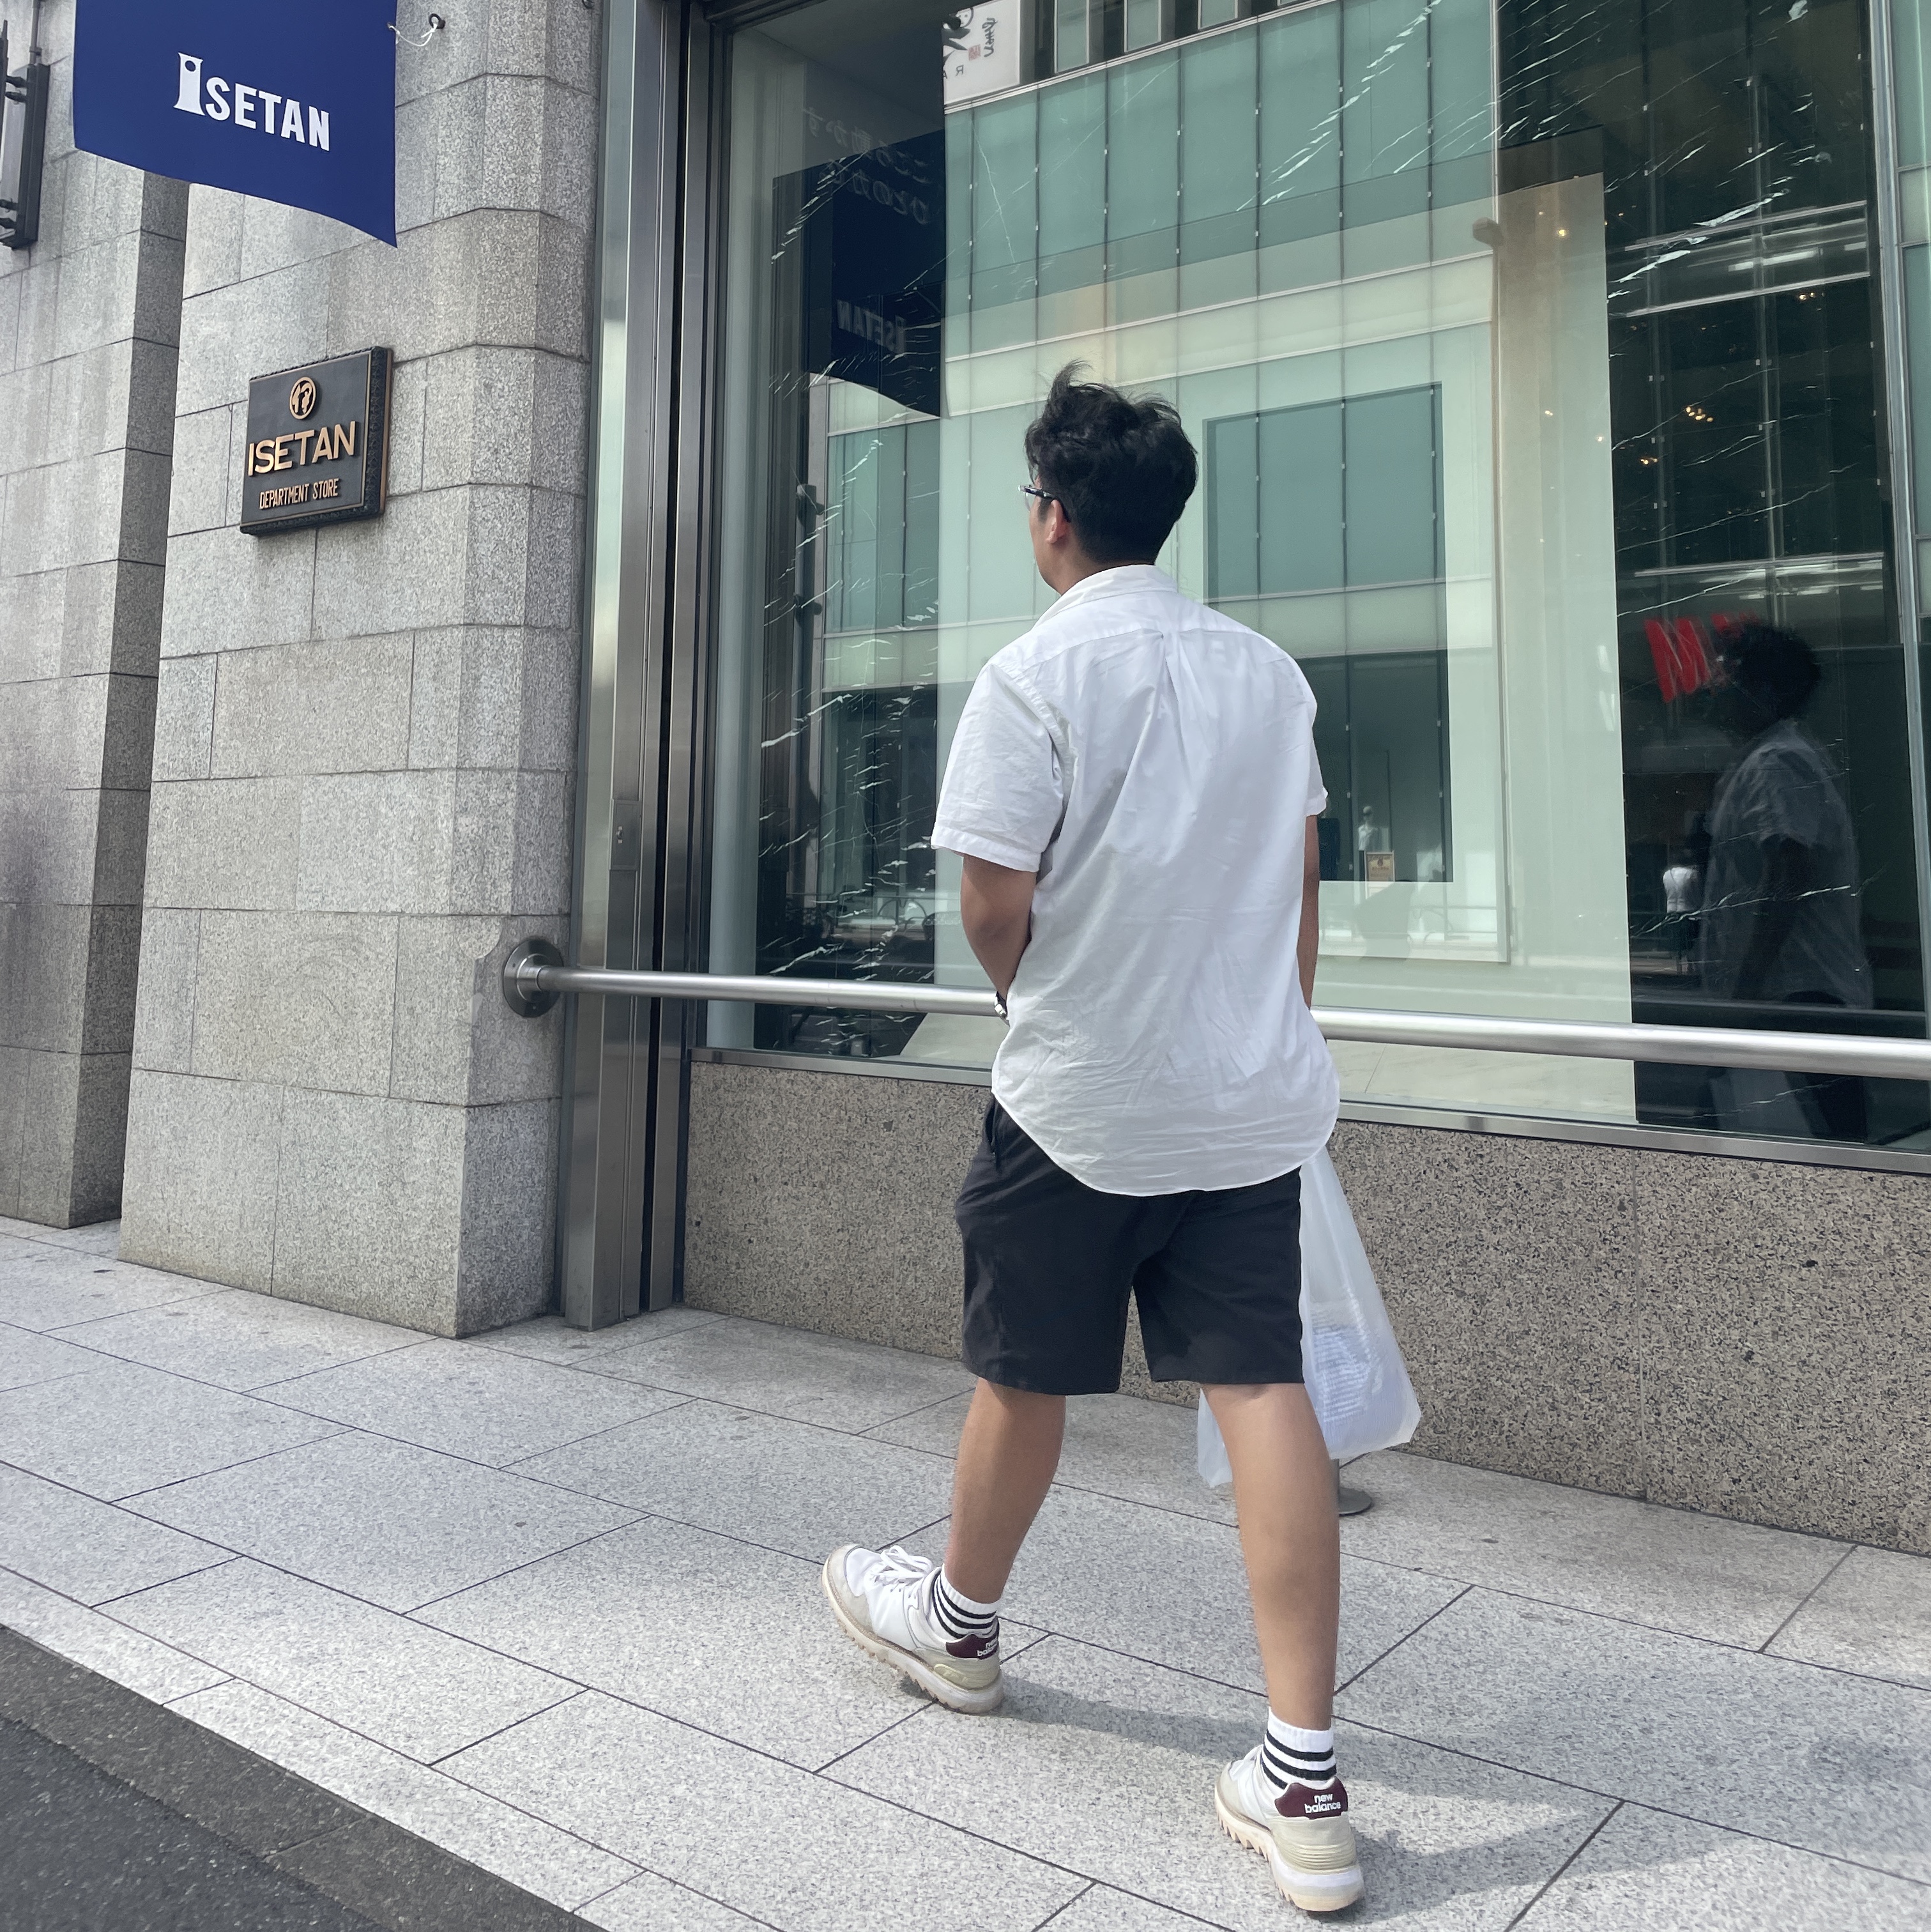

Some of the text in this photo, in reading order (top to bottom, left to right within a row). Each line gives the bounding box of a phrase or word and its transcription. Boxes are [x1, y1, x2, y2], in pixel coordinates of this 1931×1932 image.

[173, 52, 330, 151] ISETAN
[248, 420, 356, 477] ISETAN
[259, 478, 339, 510] DEPARTMENT STORE
[1304, 1802, 1341, 1814] balance
[1313, 1793, 1333, 1804] new
